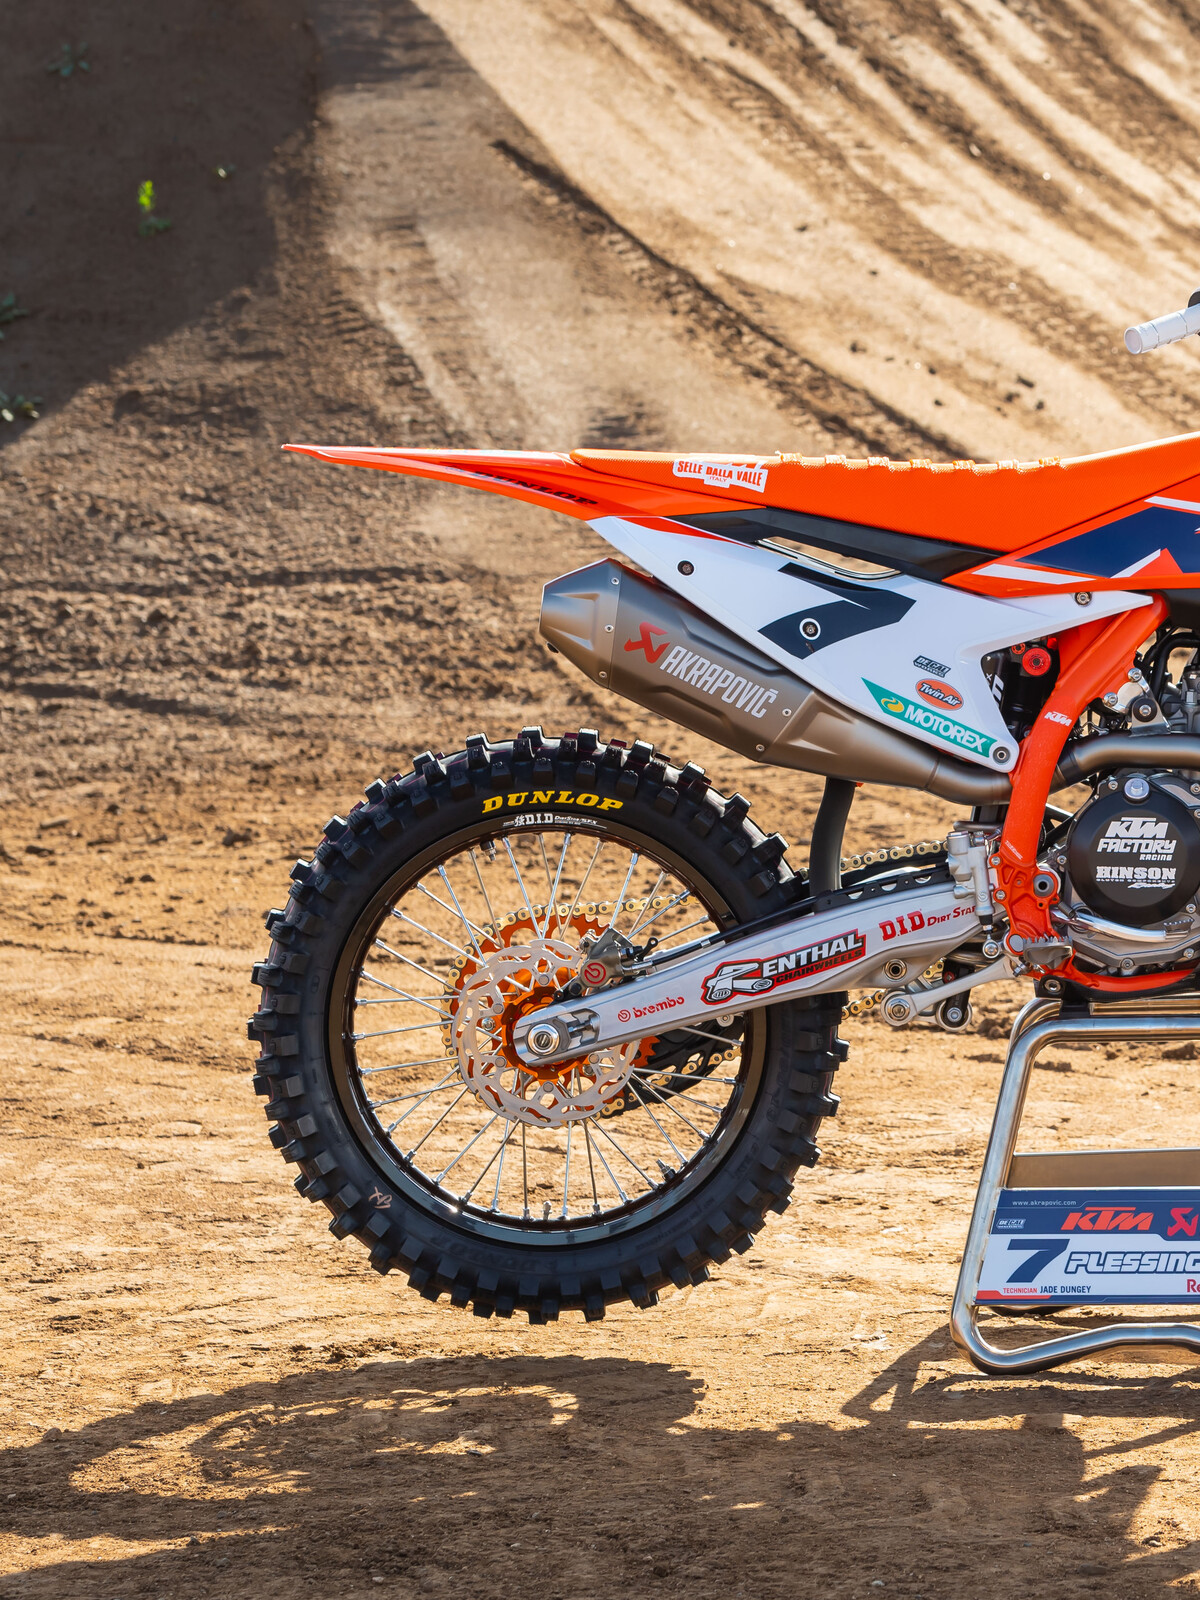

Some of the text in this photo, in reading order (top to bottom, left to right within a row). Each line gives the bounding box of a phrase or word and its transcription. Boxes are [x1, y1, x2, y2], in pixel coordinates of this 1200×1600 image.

[677, 460, 763, 487] SELLE DALLA VALLE
[757, 561, 917, 660] 7
[919, 682, 962, 706] Twin Air
[904, 704, 987, 753] MOTOREX
[1044, 711, 1072, 727] KTM
[481, 790, 624, 814] DUNLOP
[1105, 816, 1169, 839] KTM
[1096, 838, 1177, 853] FACTORY
[1139, 853, 1173, 861] RACING
[1096, 866, 1177, 880] HINSON
[879, 910, 926, 942] D.I.D
[776, 949, 863, 984] CHAINWHEELS
[632, 996, 685, 1019] brembo
[1012, 1199, 1077, 1207] www.akrapovic.com
[1060, 1206, 1155, 1231] KTM
[1006, 1238, 1071, 1284] 7
[1040, 1285, 1058, 1294] JADE
[1060, 1285, 1092, 1294] DUNGEY
